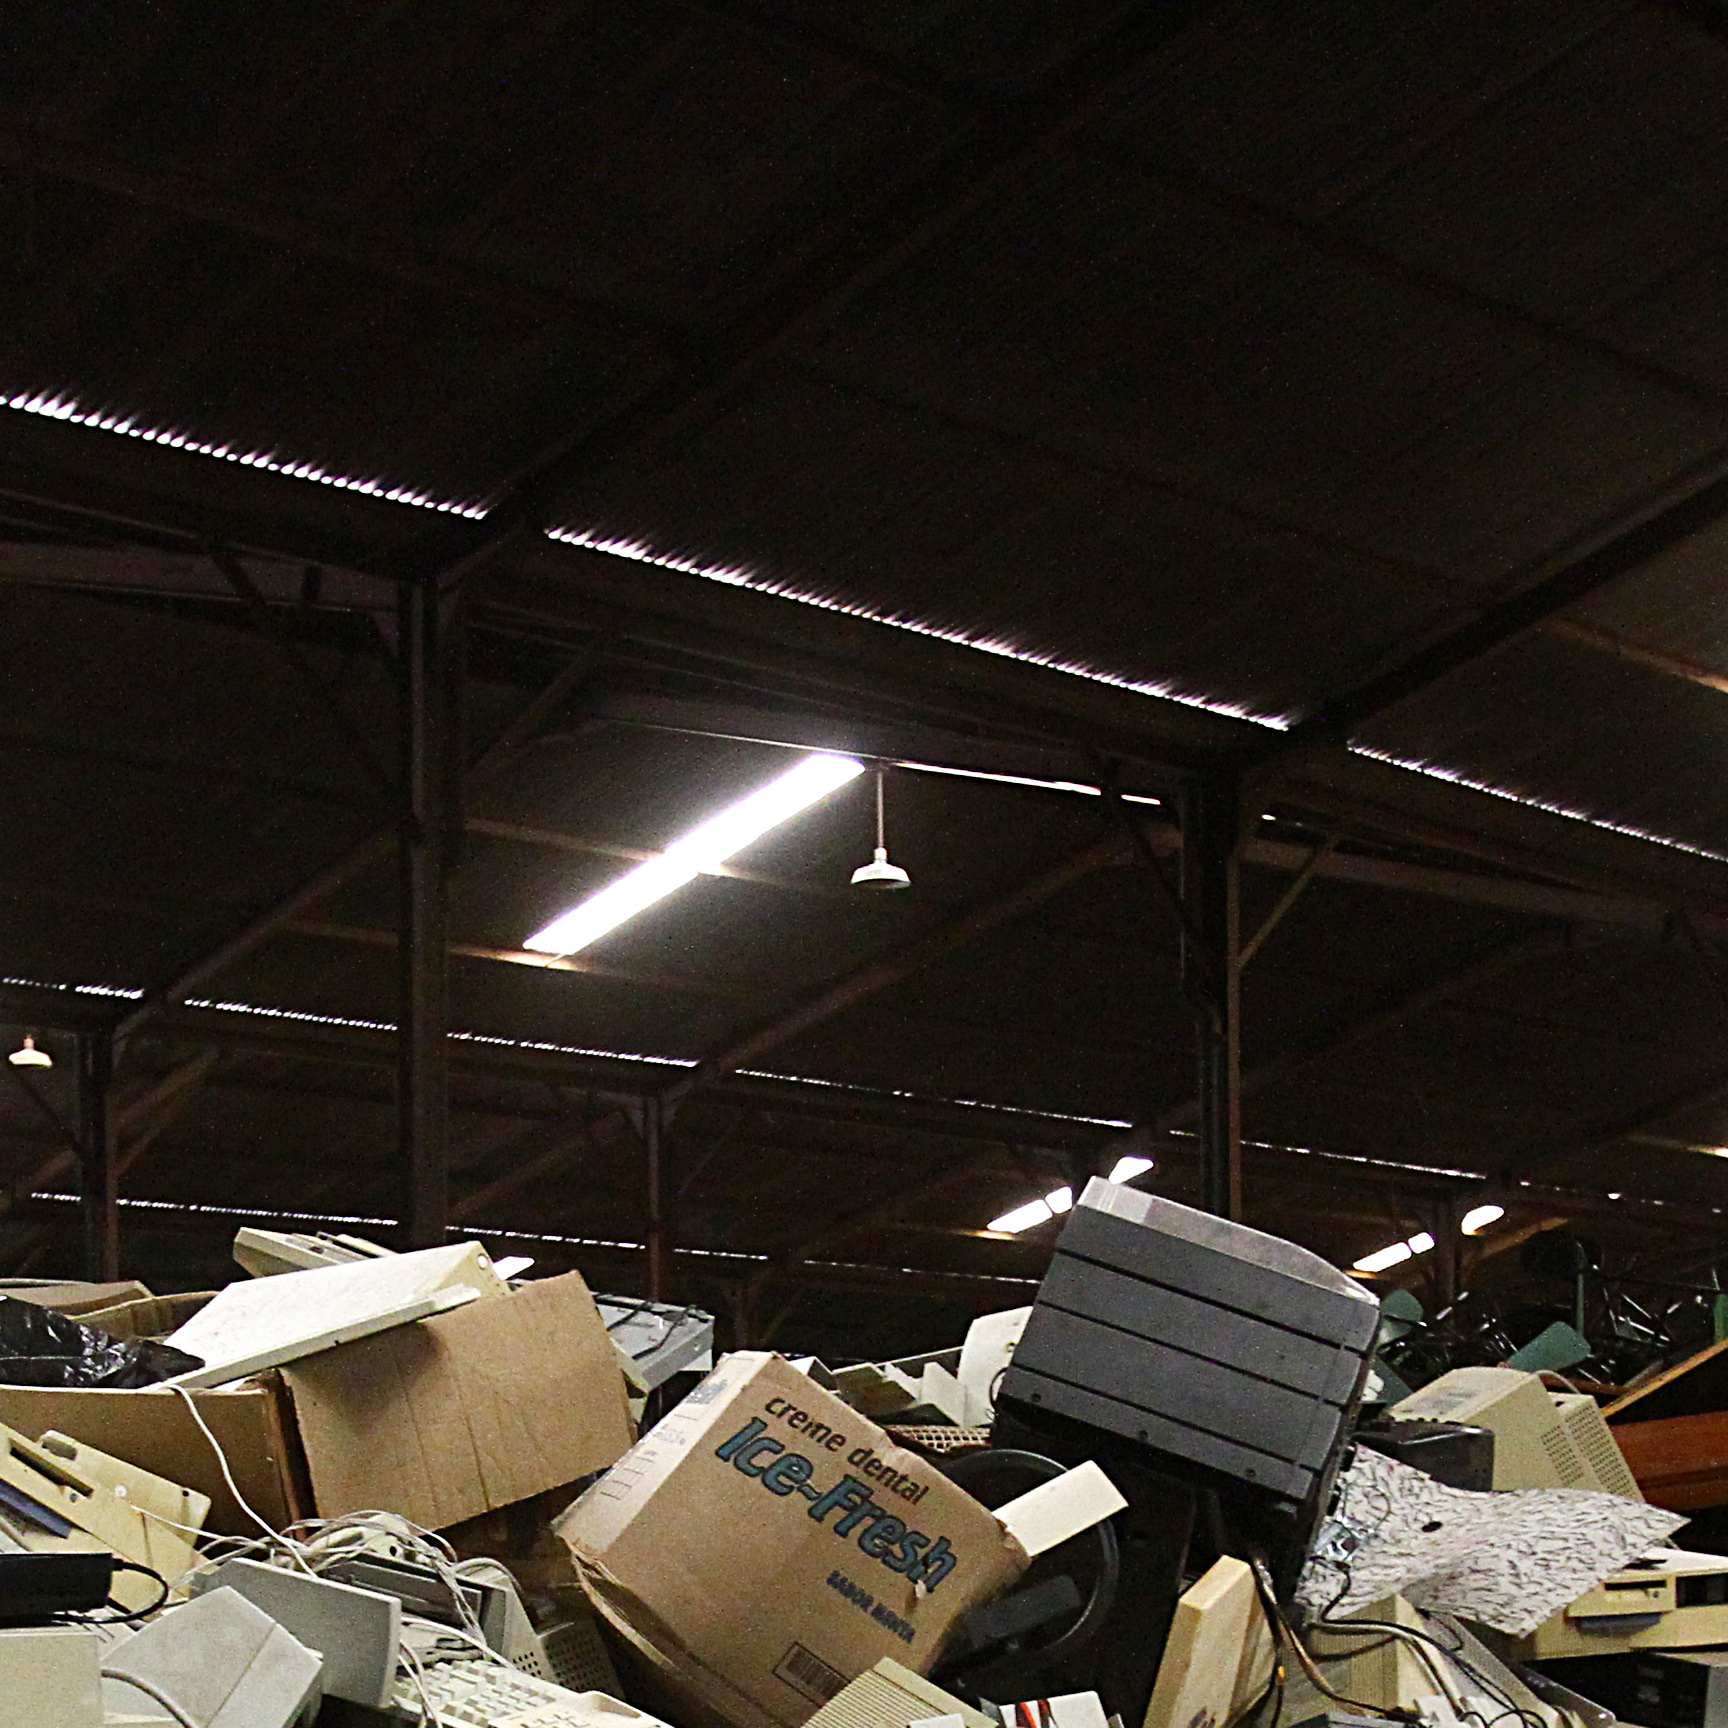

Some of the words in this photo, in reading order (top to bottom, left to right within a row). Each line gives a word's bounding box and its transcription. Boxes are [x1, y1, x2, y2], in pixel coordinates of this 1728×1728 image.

[764, 1396, 847, 1452] creme
[846, 1447, 930, 1506] dental
[826, 1570, 874, 1612] SABOR
